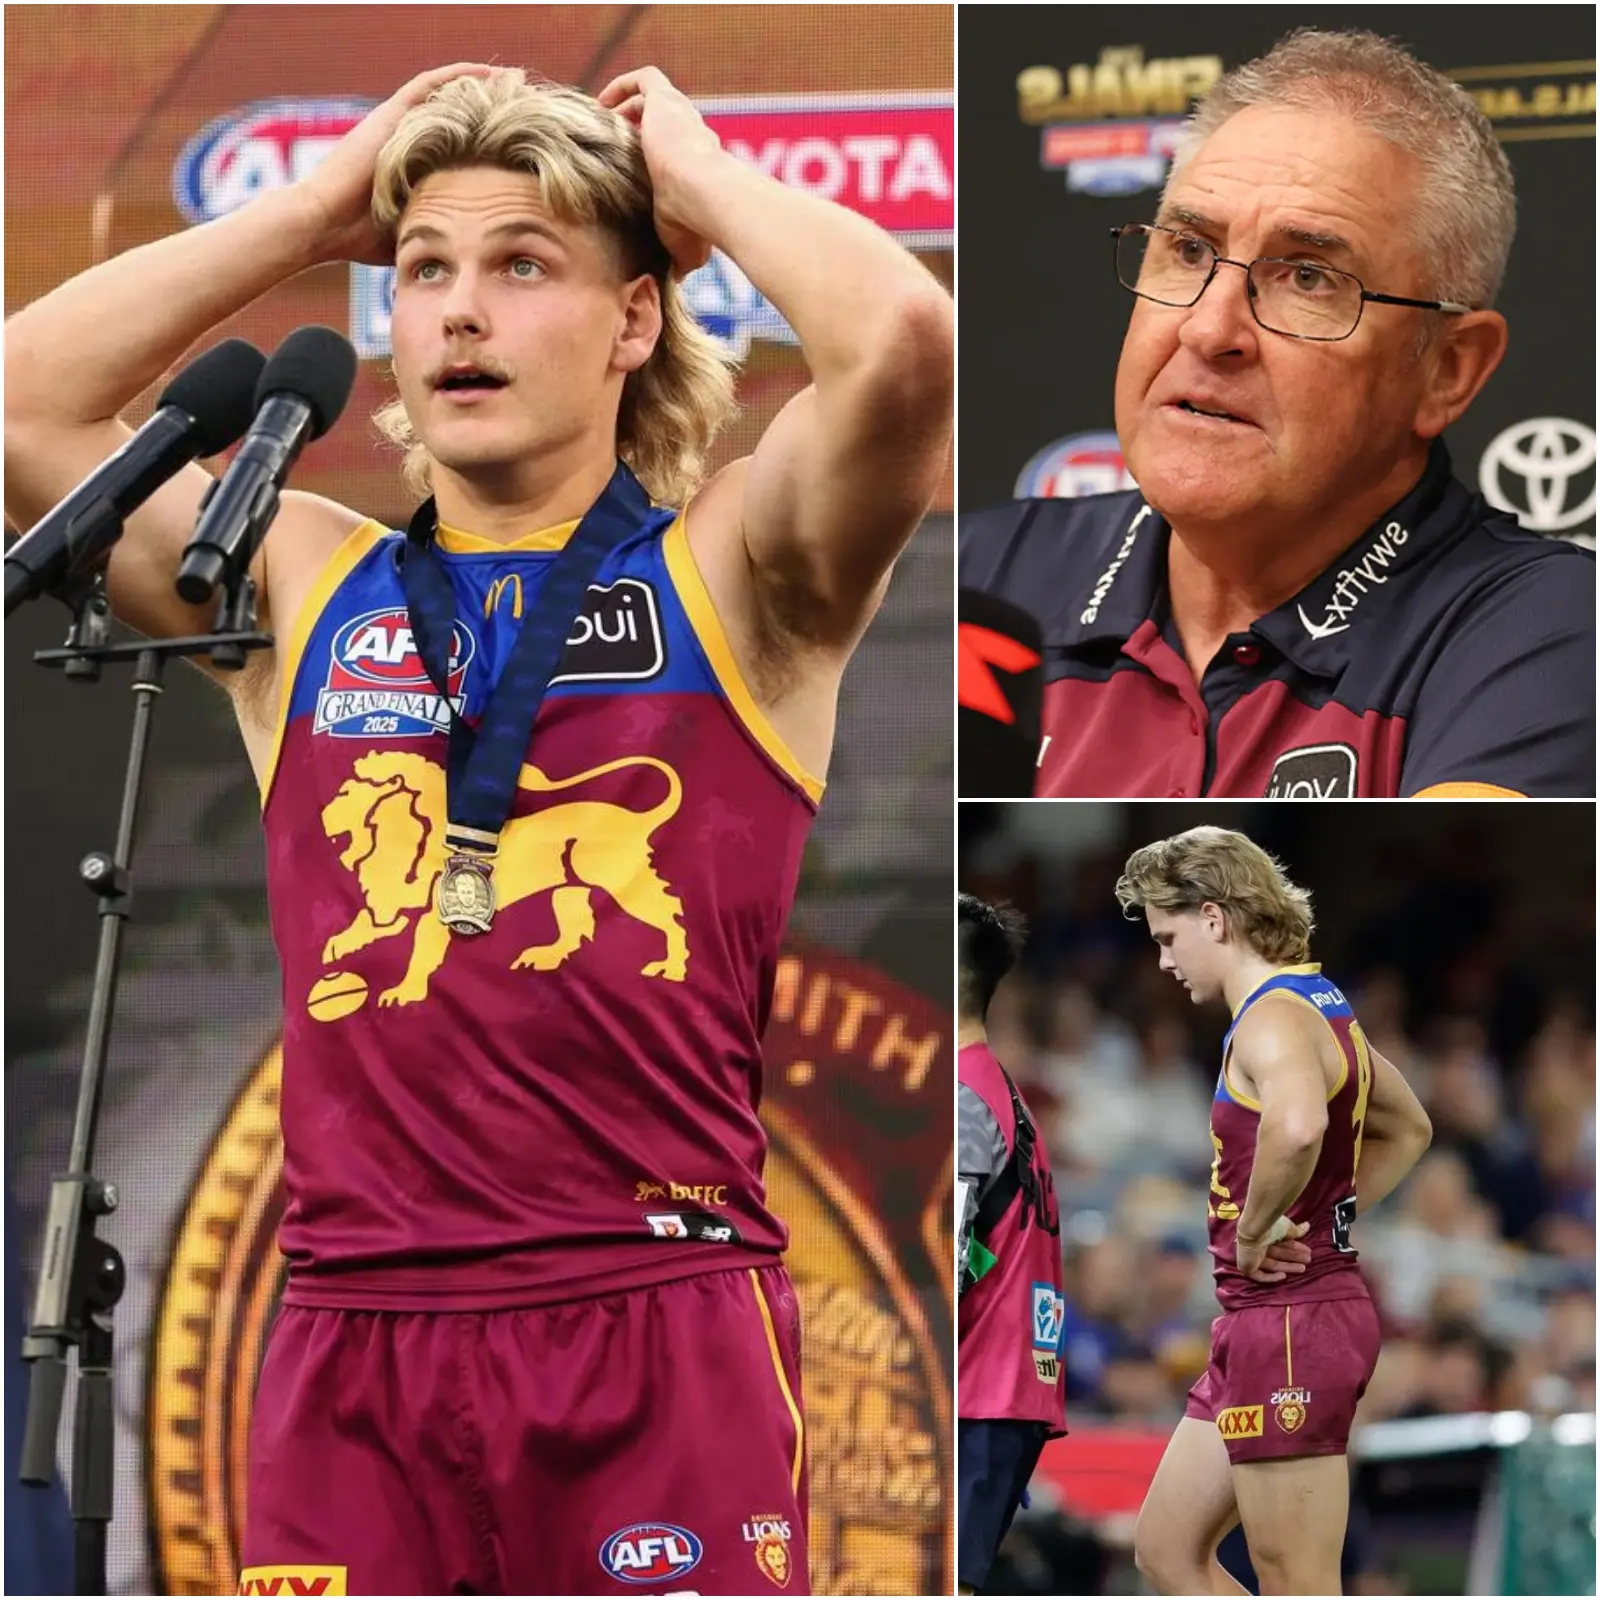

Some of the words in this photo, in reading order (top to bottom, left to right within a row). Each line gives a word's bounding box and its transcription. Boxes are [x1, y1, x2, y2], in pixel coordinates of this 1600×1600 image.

[726, 134, 951, 202] YOTA
[565, 594, 638, 645] oui
[342, 626, 458, 668] AF
[322, 691, 387, 722] GRAND
[362, 716, 400, 733] 2025
[742, 1520, 792, 1542] LIONS
[612, 1535, 695, 1572] AFL
